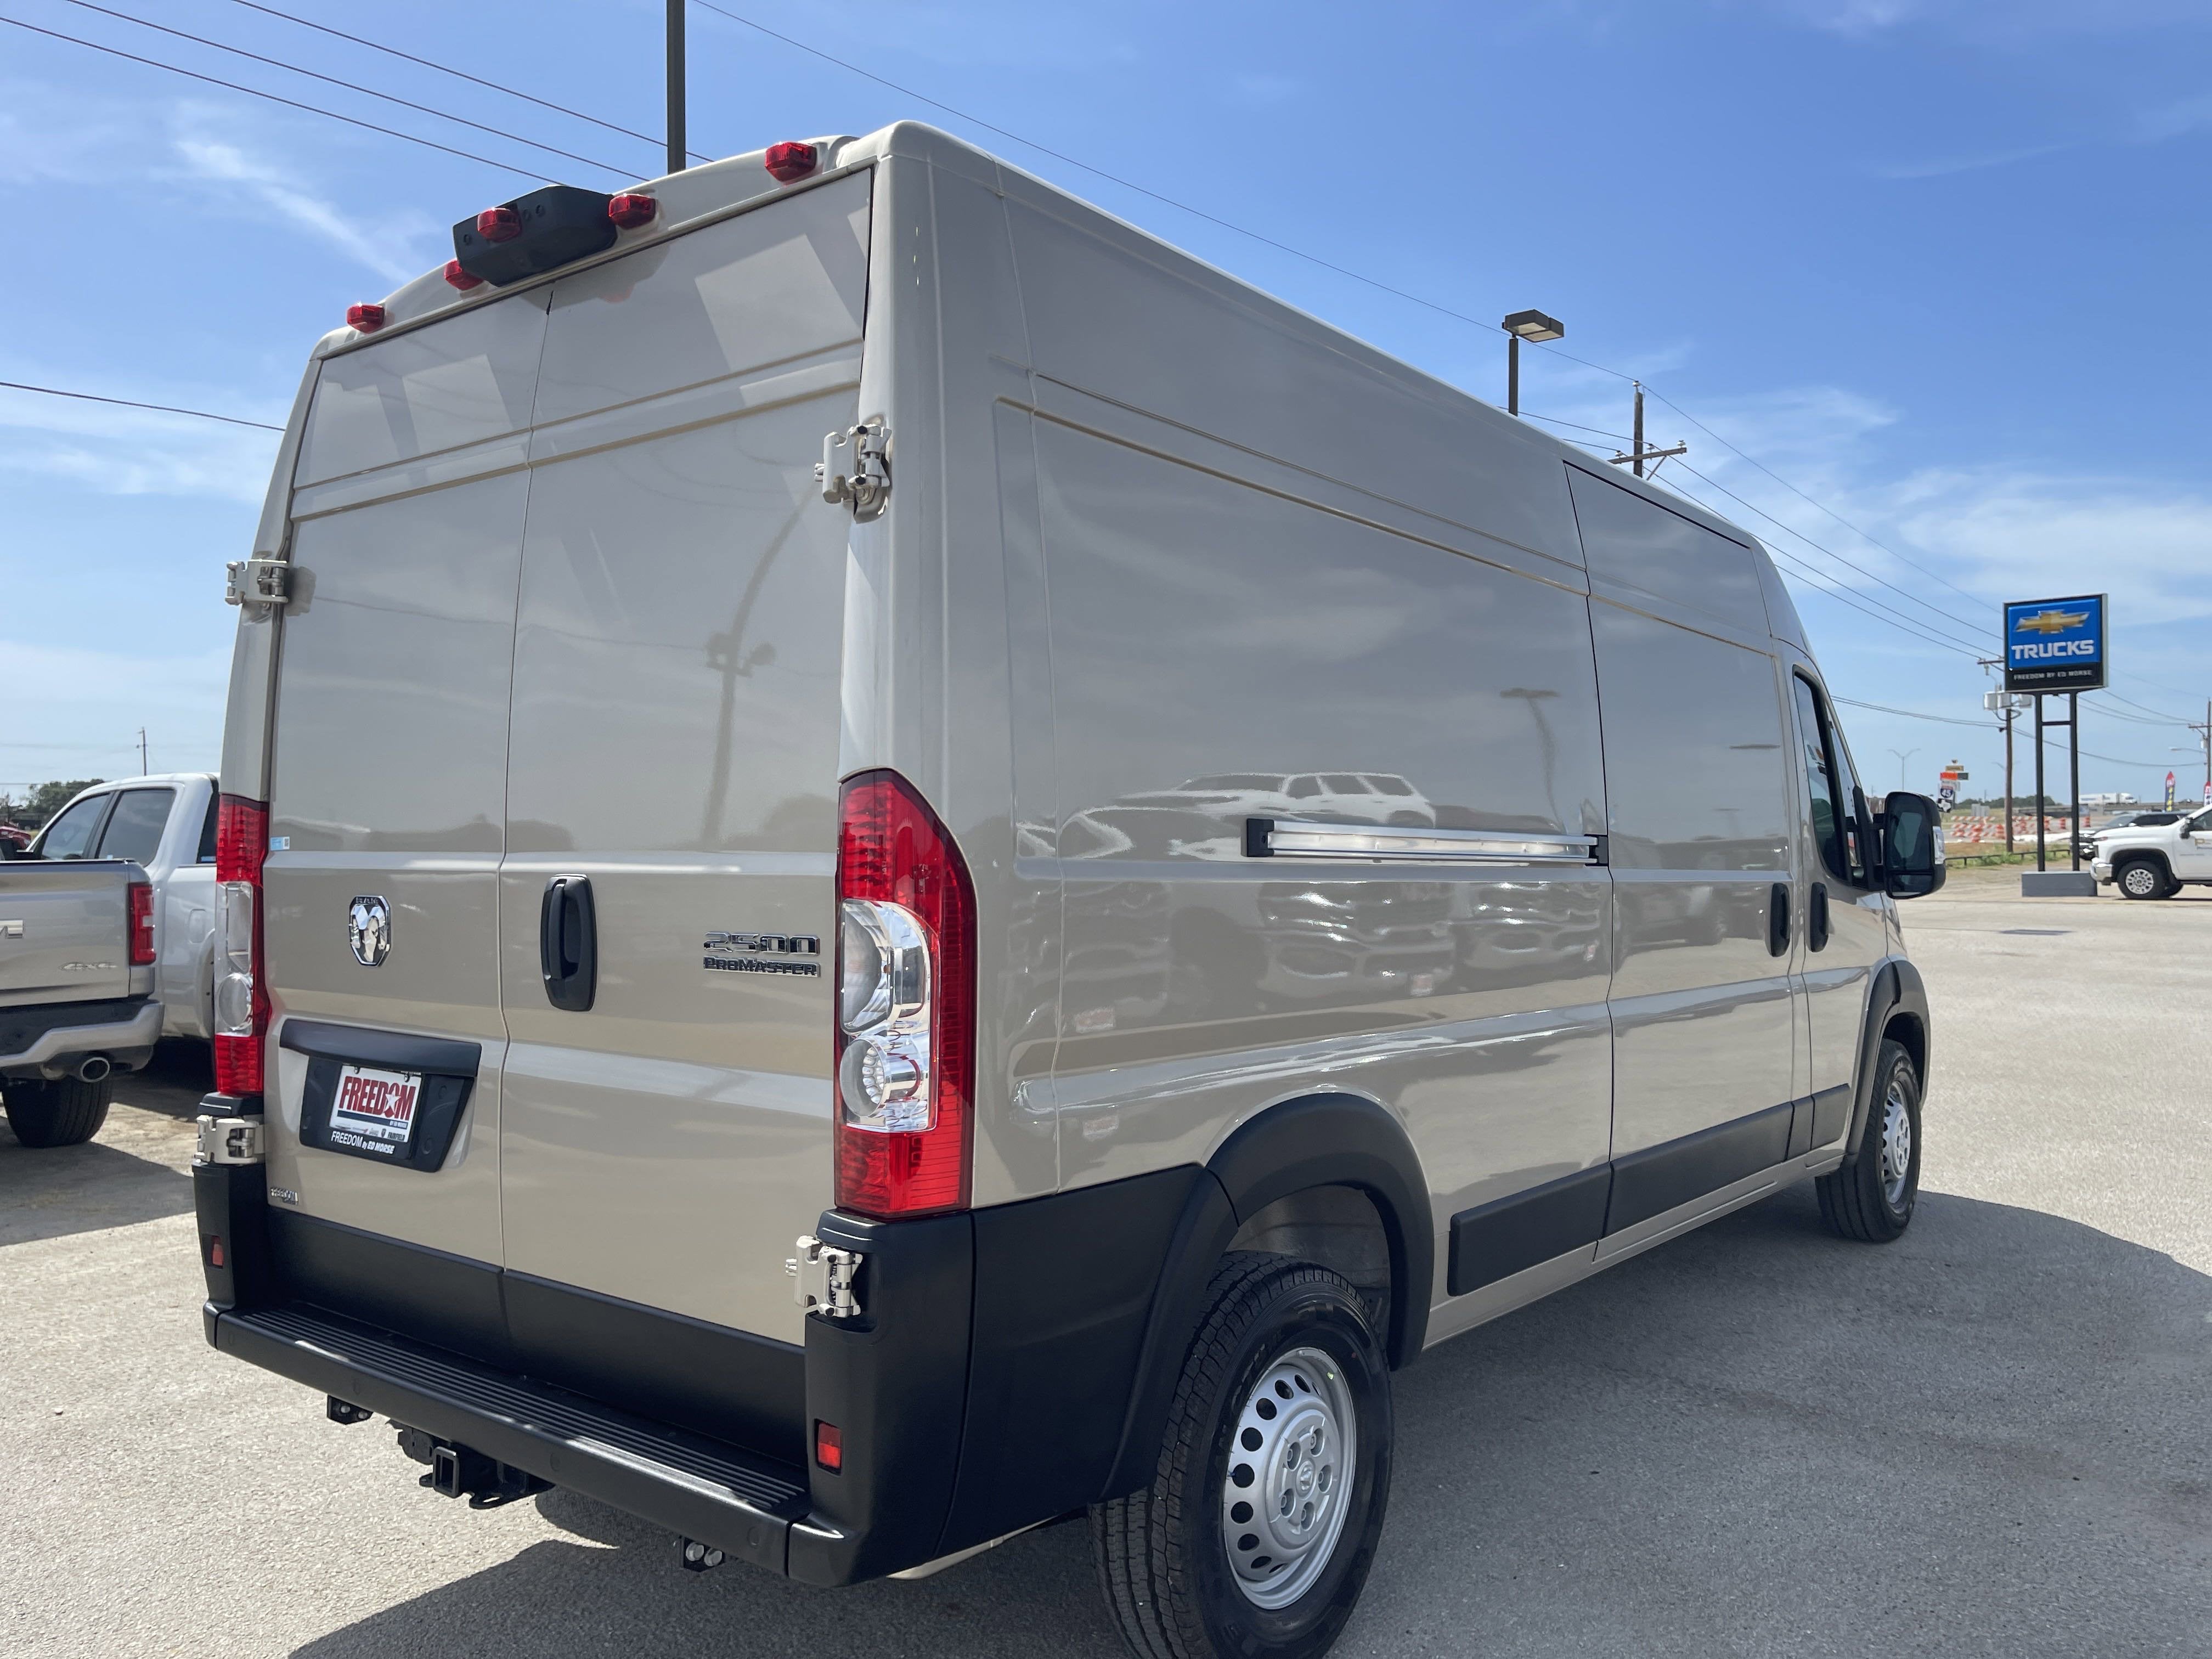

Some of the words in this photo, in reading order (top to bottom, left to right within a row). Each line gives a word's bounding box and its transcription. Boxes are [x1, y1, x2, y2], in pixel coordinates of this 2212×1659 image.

[2011, 640, 2094, 659] TRUCKS
[1942, 789, 1950, 797] 45
[704, 932, 820, 956] 2500
[338, 1076, 416, 1120] FREEDOM
[331, 1131, 363, 1147] FREEDOM
[367, 1141, 376, 1150] ED
[375, 1143, 395, 1154] MORSE
[387, 1132, 405, 1141] FAIRFIELD
